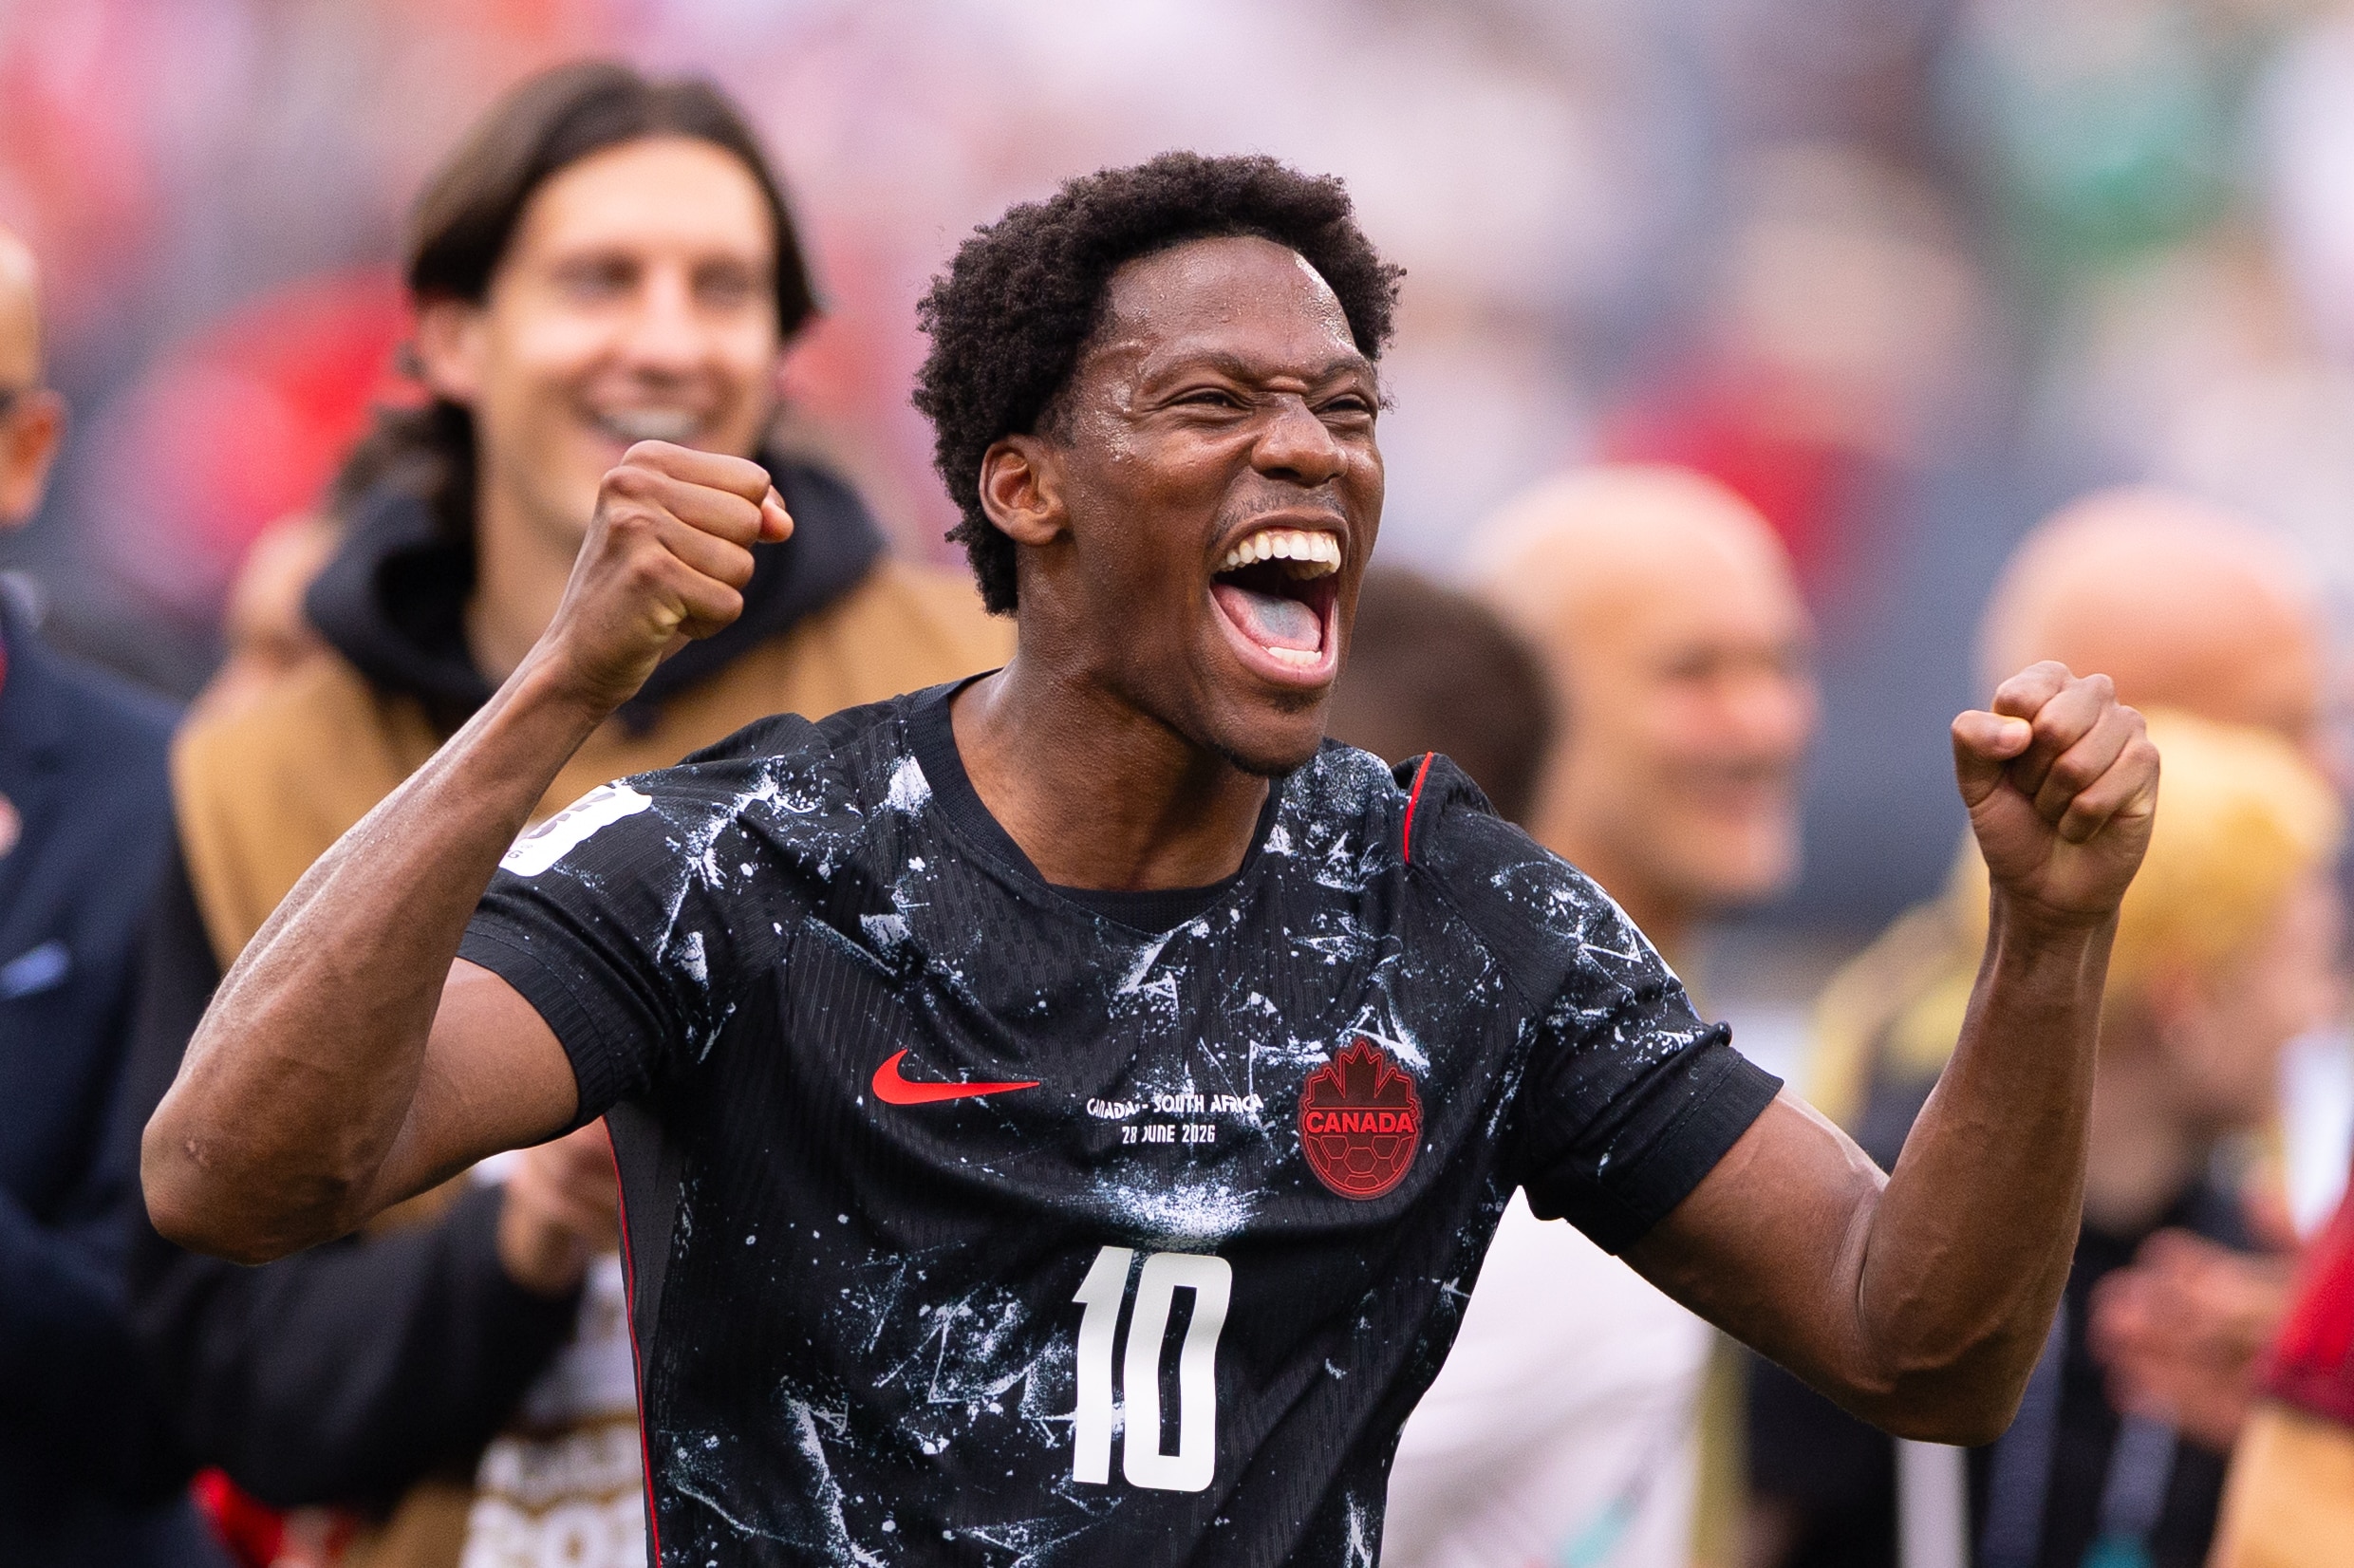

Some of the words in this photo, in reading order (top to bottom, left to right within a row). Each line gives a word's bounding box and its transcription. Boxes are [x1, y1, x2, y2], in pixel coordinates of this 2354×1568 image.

[1087, 1098, 1137, 1120] CANADA
[1153, 1094, 1205, 1113] SOUTH
[1210, 1093, 1264, 1113] AFRICA
[1306, 1111, 1415, 1133] CANADA
[1122, 1126, 1138, 1144] 28
[1141, 1125, 1175, 1143] JUNE
[1182, 1125, 1216, 1143] 2026
[1072, 1245, 1233, 1492] 10
